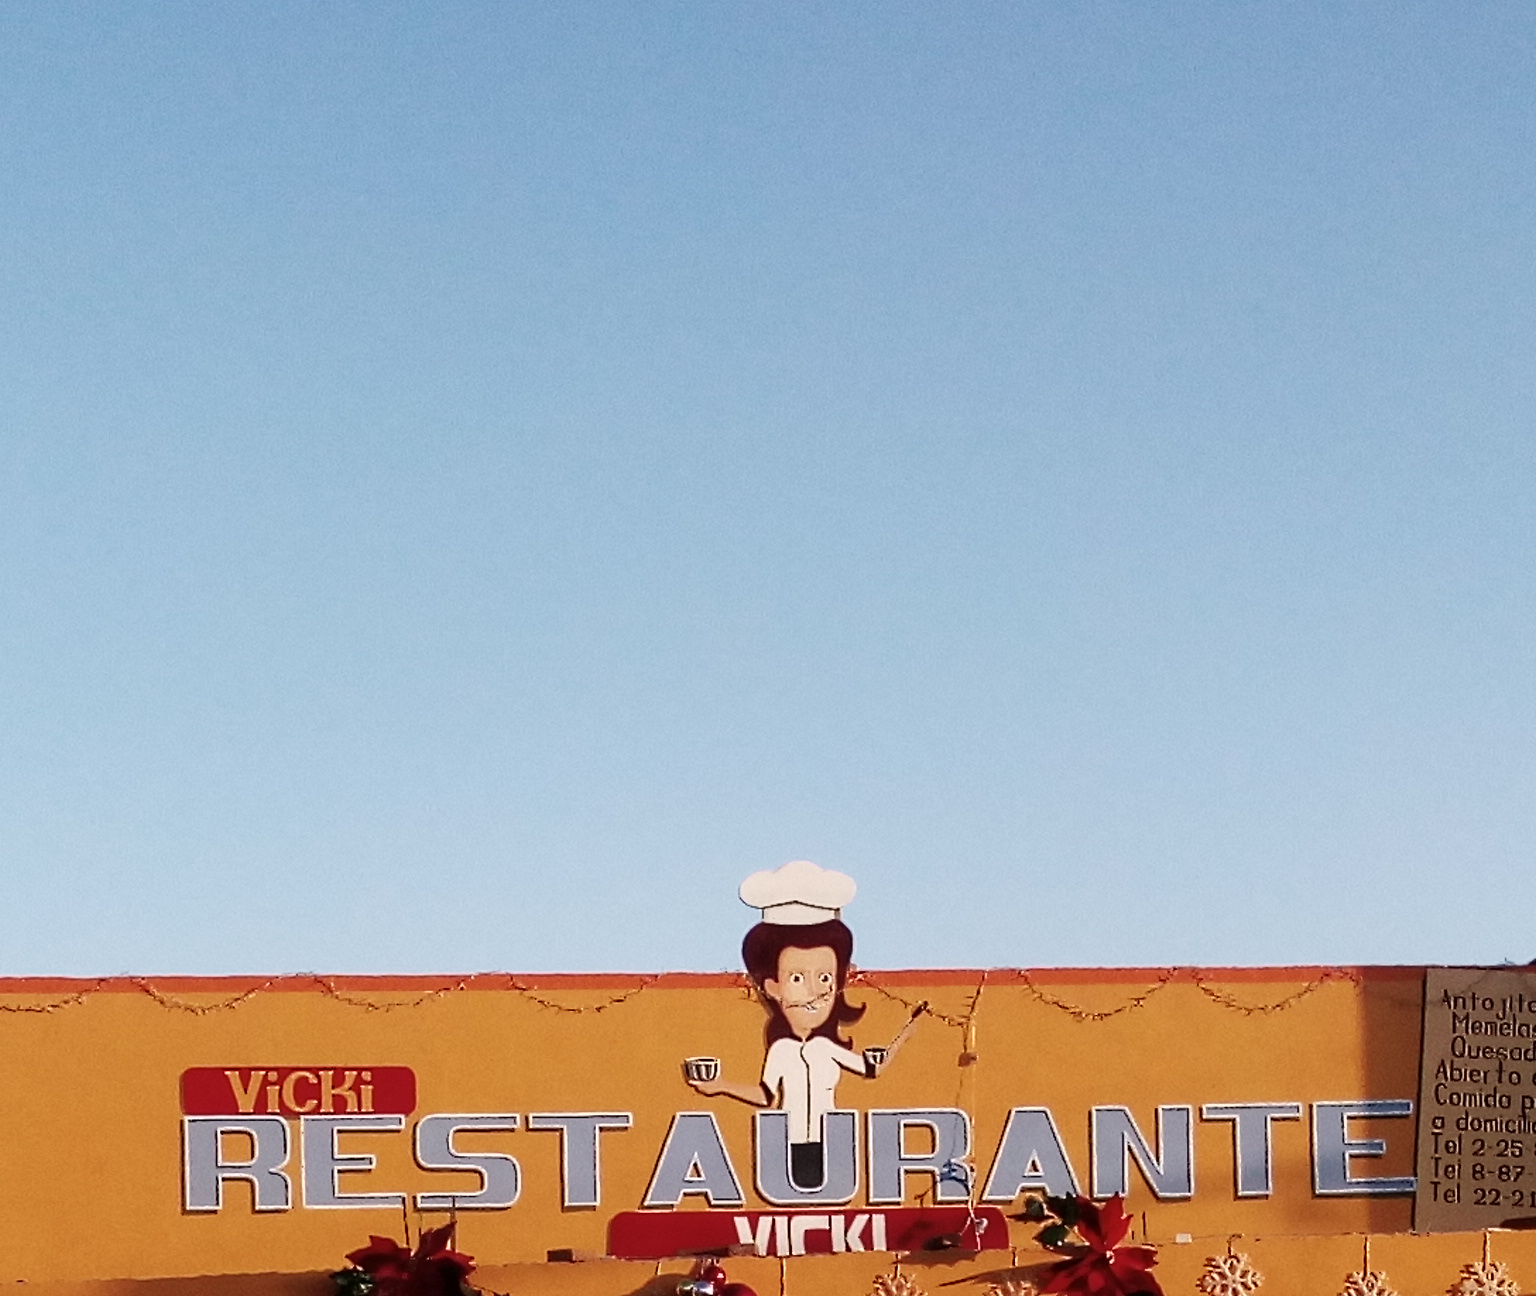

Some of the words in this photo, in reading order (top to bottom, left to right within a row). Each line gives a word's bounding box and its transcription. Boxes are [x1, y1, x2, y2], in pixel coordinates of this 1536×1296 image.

[1435, 1060, 1522, 1087] Abierto
[1434, 1083, 1512, 1109] Comida
[1432, 1116, 1445, 1130] a
[1430, 1132, 1462, 1155] Tel
[182, 1101, 1417, 1212] RESTAURANTE
[1431, 1157, 1462, 1180] Tel
[1429, 1181, 1461, 1205] Tel
